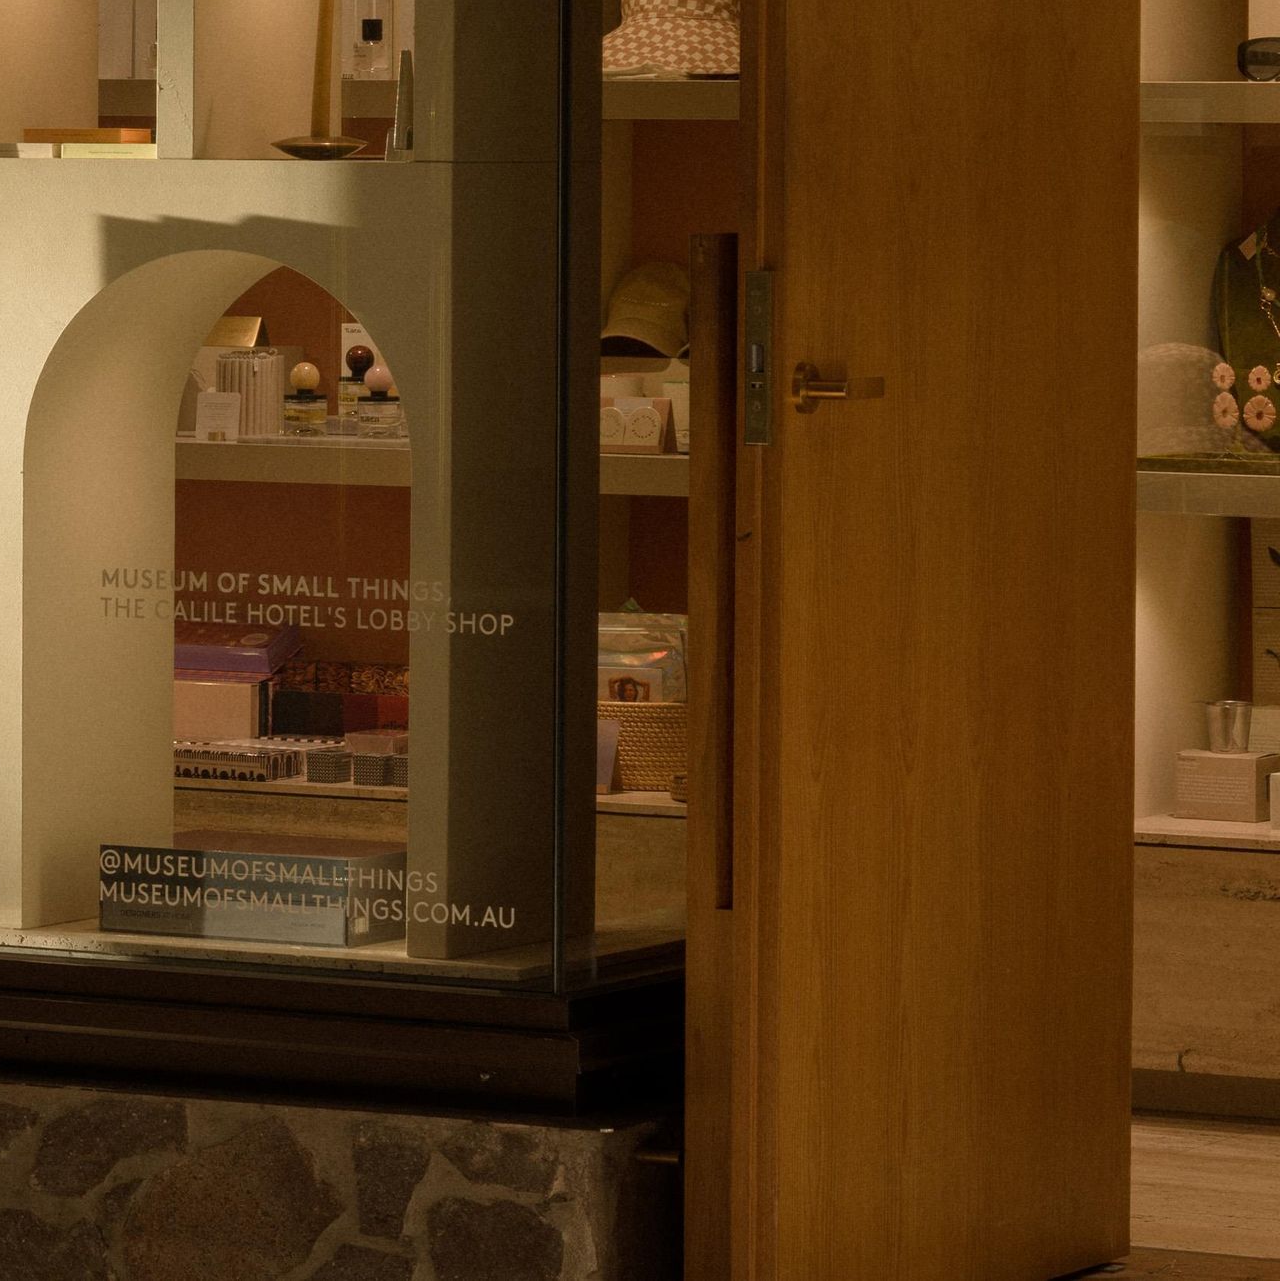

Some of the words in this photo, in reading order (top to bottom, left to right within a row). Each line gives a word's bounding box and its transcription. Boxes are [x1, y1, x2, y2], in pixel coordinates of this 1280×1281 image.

[101, 568, 208, 592] MUSEUM
[217, 572, 249, 594] OF
[256, 573, 339, 599] SMALL
[348, 577, 452, 606] THINGS,
[100, 596, 146, 618] THE
[154, 599, 236, 624] CALILE
[248, 603, 347, 630] HOTEL'S
[357, 607, 441, 633] LOBBY
[445, 612, 514, 636] SHOP
[100, 849, 439, 895] @MUSEUMOFSMALLTHINGS
[100, 880, 516, 930] MUSEUMOFSMALLTHINGS.COM.AU
